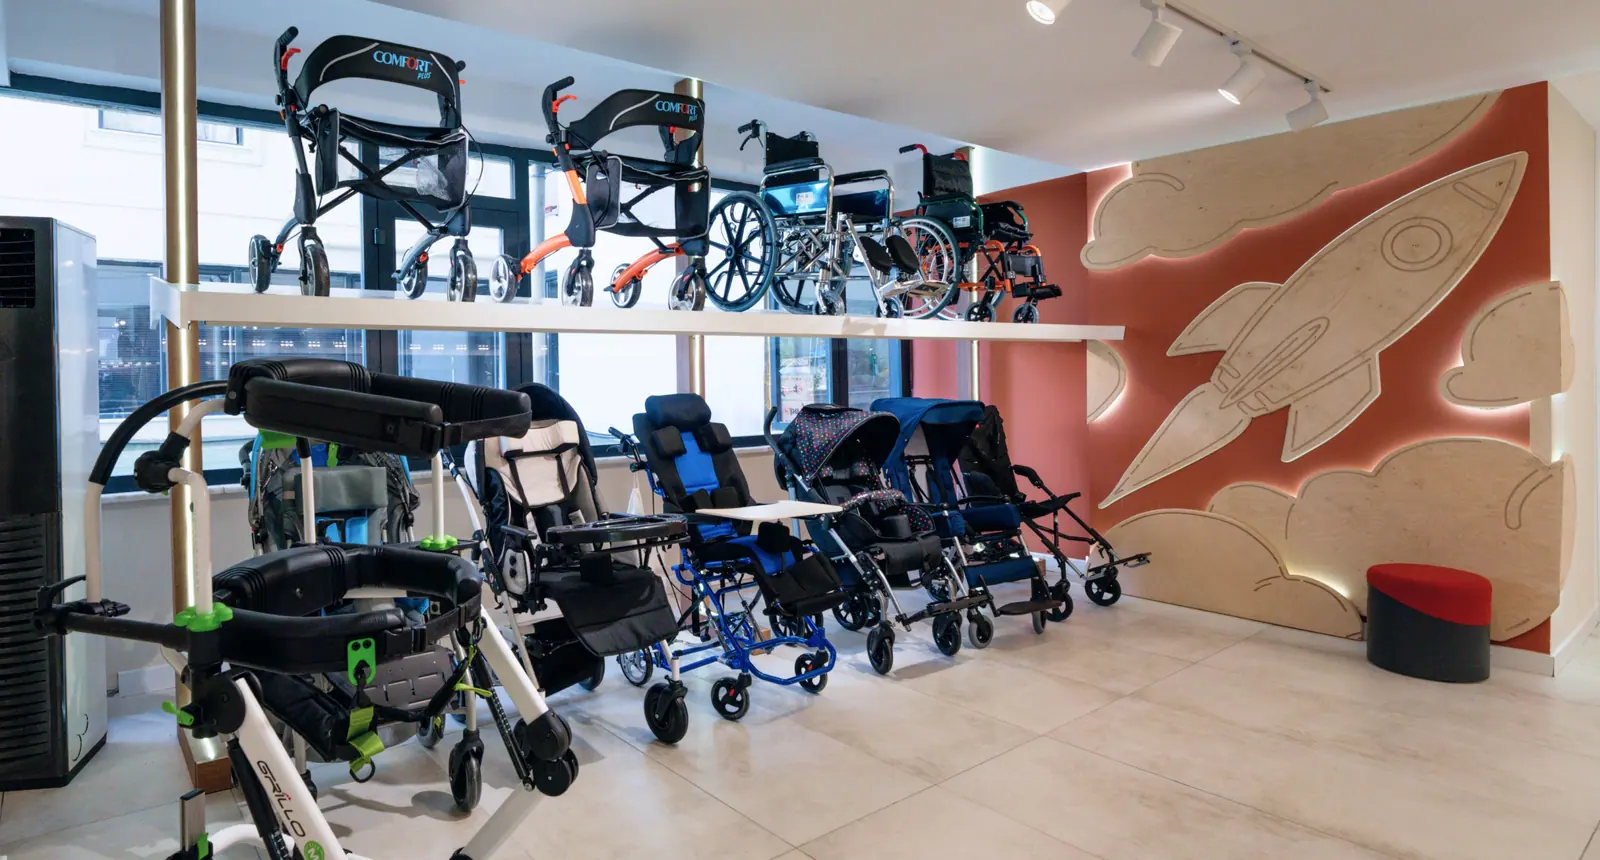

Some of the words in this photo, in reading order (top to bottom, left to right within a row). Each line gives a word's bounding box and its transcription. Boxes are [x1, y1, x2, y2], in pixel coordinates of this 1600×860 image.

[373, 50, 432, 72] COMFORT
[417, 72, 432, 80] PLUS
[655, 100, 698, 115] COMFORT
[256, 760, 306, 837] GRILLO
